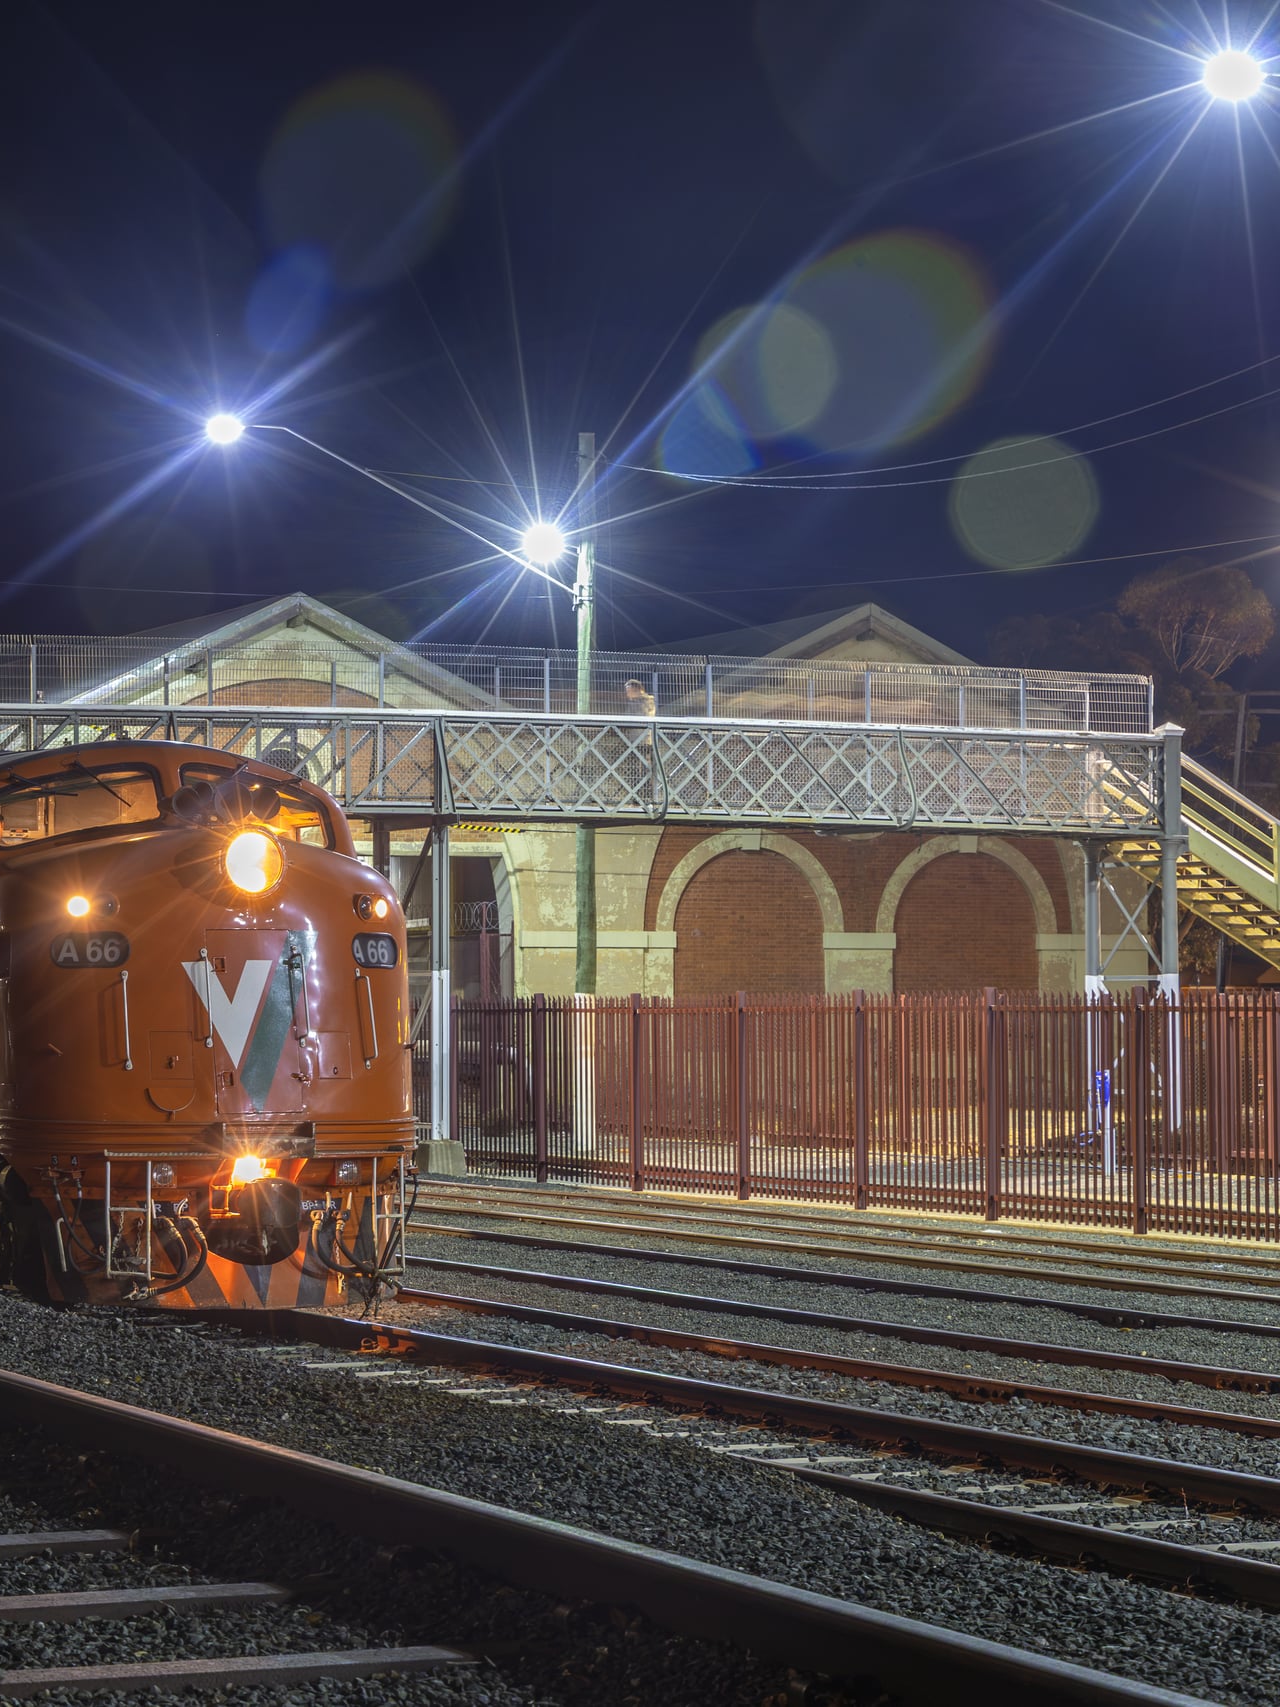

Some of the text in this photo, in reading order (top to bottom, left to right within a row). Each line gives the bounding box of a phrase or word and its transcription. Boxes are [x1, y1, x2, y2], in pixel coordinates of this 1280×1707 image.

[57, 938, 120, 962] A 66
[353, 939, 389, 964] A 66
